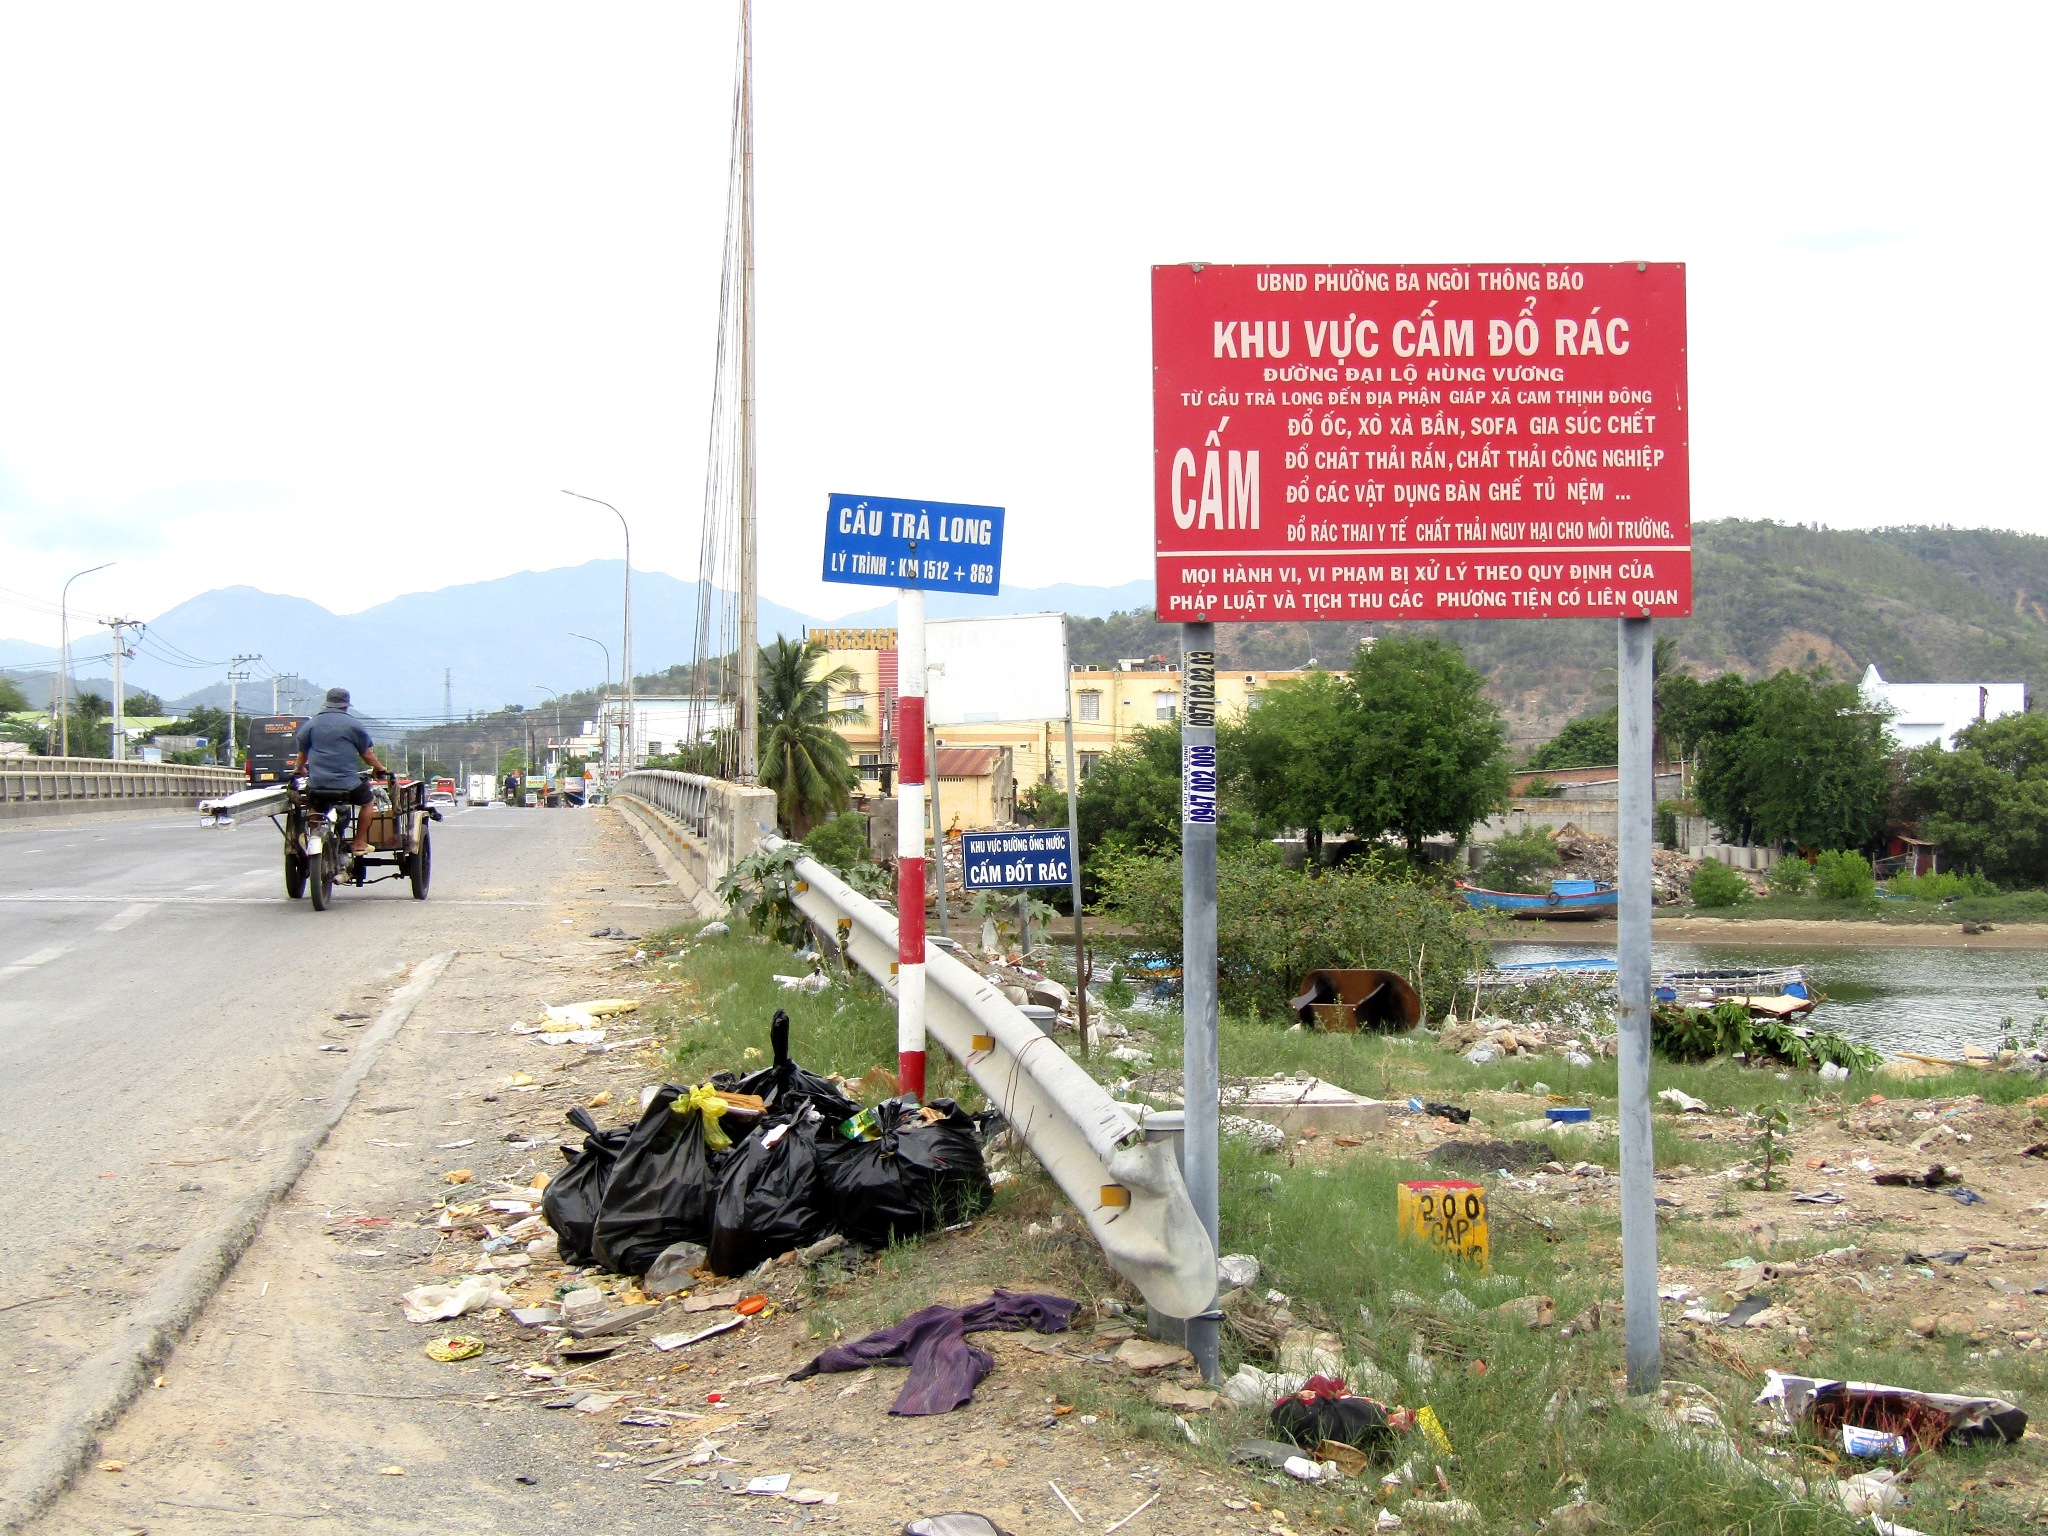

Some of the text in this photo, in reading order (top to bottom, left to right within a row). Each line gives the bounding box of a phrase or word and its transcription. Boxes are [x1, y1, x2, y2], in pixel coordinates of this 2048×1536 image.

[1256, 266, 1584, 292] UBND PHƯỜNG BA NGÒI THÔNG BÁO
[1214, 296, 1630, 366] KHU VỰC CẤM ĐỔ RÁC
[1263, 362, 1564, 385] ĐƯỜNG ĐẠI LỘ HÙNG VƯƠNG
[1181, 388, 1203, 406] TỪ
[1207, 386, 1240, 406] CẦU
[1281, 391, 1324, 405] LONG
[1327, 385, 1361, 405] ĐẾN
[1366, 391, 1393, 408] ĐỊA
[1398, 386, 1441, 407] PHẬN
[1450, 387, 1486, 405] GIÁP
[1490, 386, 1512, 405] XÃ
[1517, 390, 1551, 404] CAM
[1556, 390, 1604, 407] THỊNH
[1608, 386, 1652, 404] ĐÔNG
[1288, 408, 1314, 436] ĐỔ
[1320, 410, 1352, 439] ỐC,
[1358, 412, 1383, 436] XÒ
[1390, 413, 1414, 436] XÀ
[1471, 416, 1518, 436] SOFA
[1529, 416, 1560, 435] GIA
[1565, 409, 1602, 435] SÚC
[1607, 407, 1656, 434] CHẾT
[1285, 442, 1309, 470] ĐỔ
[1365, 444, 1405, 470] THẢI
[1411, 441, 1453, 472] RẮN,
[1456, 441, 1501, 468] CHẤT
[1507, 442, 1547, 468] THẢI
[1552, 445, 1598, 468] CÔNG
[1602, 444, 1665, 472] NGHIỆP
[1171, 416, 1260, 530] CẤM
[1286, 475, 1310, 503] ĐỔ
[1315, 480, 1350, 503] CÁC
[1354, 478, 1386, 508] VẬT
[1394, 484, 1440, 508] DỤNG
[1445, 479, 1481, 502] BÀN
[1488, 475, 1524, 501] GHẾ
[1533, 475, 1555, 500] TỦ
[1567, 477, 1604, 506] NỆM
[839, 501, 992, 546] CẦU TRÀ LONG
[1287, 514, 1306, 542] ĐỔ
[1310, 519, 1338, 542] RÁC
[1376, 524, 1386, 542] Y
[1390, 515, 1408, 542] TẾ
[1415, 516, 1451, 542] CHẤT
[1454, 516, 1487, 541] THẢI
[1490, 522, 1526, 541] NGUY
[1529, 521, 1553, 543] HẠI
[1556, 521, 1584, 540] CHO
[1587, 516, 1613, 540] MÔI
[1616, 515, 1675, 540] TRƯỜNG.
[831, 550, 847, 572] LÝ
[852, 551, 887, 576] TRÌNH
[898, 558, 919, 578] KM
[923, 560, 949, 581] 1512
[970, 563, 994, 584] 863
[1181, 558, 1655, 588] MỌI HÀNH VI, VI PHẠM BỊ XỬ LÝ THEO QUY ĐỊNH CỦA
[1169, 586, 1678, 613] PHÁP LUẬT VÀ TỊCH THU CÁC PHƯƠNG TIỆN CÓ LIÊN QUAN
[809, 628, 898, 650] MASSAGE
[1189, 651, 1214, 727] 0971 02 02 03
[1190, 746, 1215, 823] 0947 002 009
[970, 833, 1066, 855] KHU VỰC ĐƯỜNG ỐNG NƯỚC
[970, 857, 1067, 883] CẤM ĐỐT RÁC
[1420, 1193, 1480, 1221] 200
